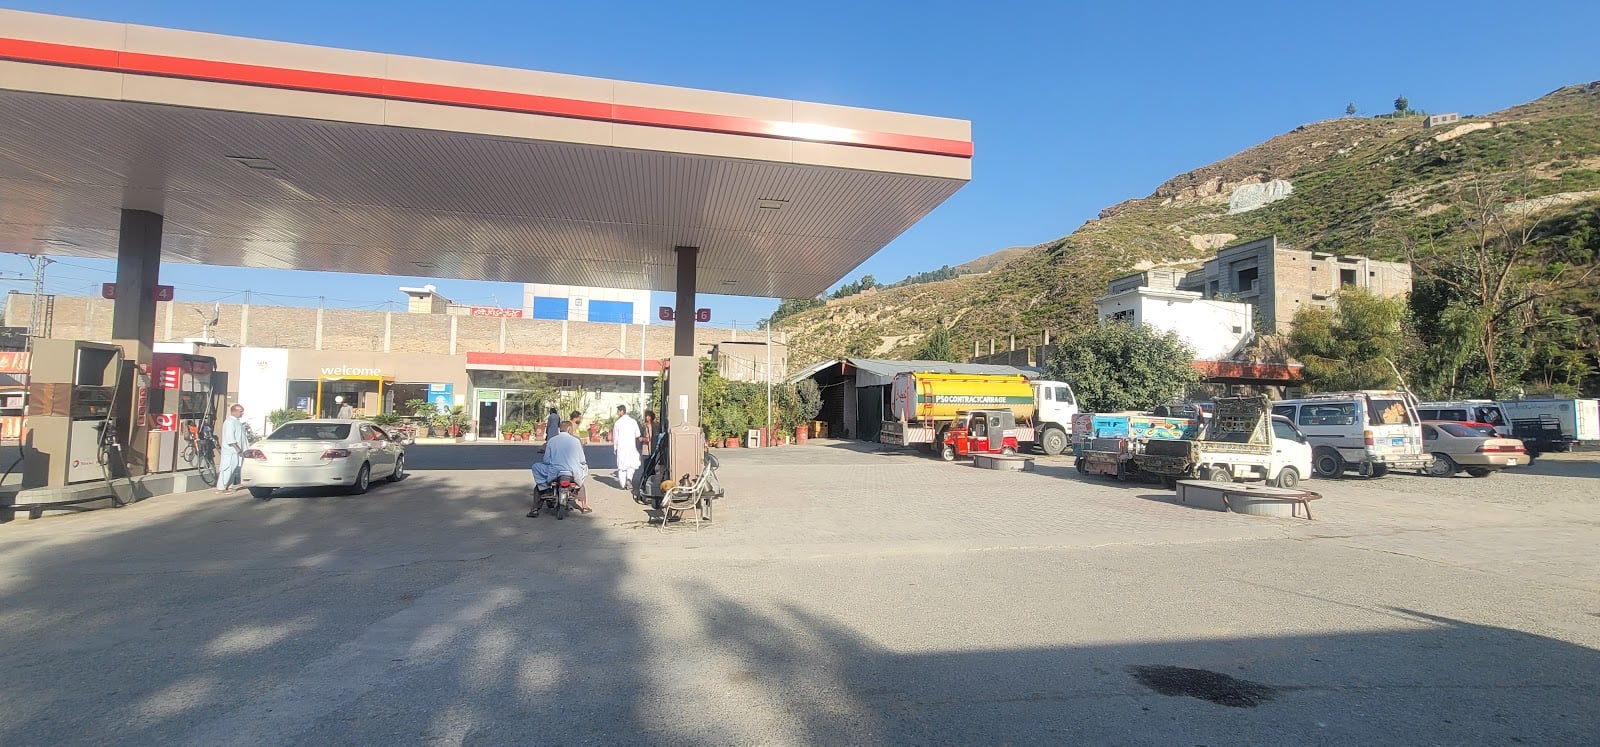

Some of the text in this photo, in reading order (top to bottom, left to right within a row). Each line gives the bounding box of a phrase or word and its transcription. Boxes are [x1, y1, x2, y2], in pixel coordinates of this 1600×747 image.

[106, 285, 114, 296] 3
[158, 289, 168, 299] 4
[663, 309, 670, 318] 5
[701, 311, 708, 320] 6
[320, 364, 382, 376] welcome
